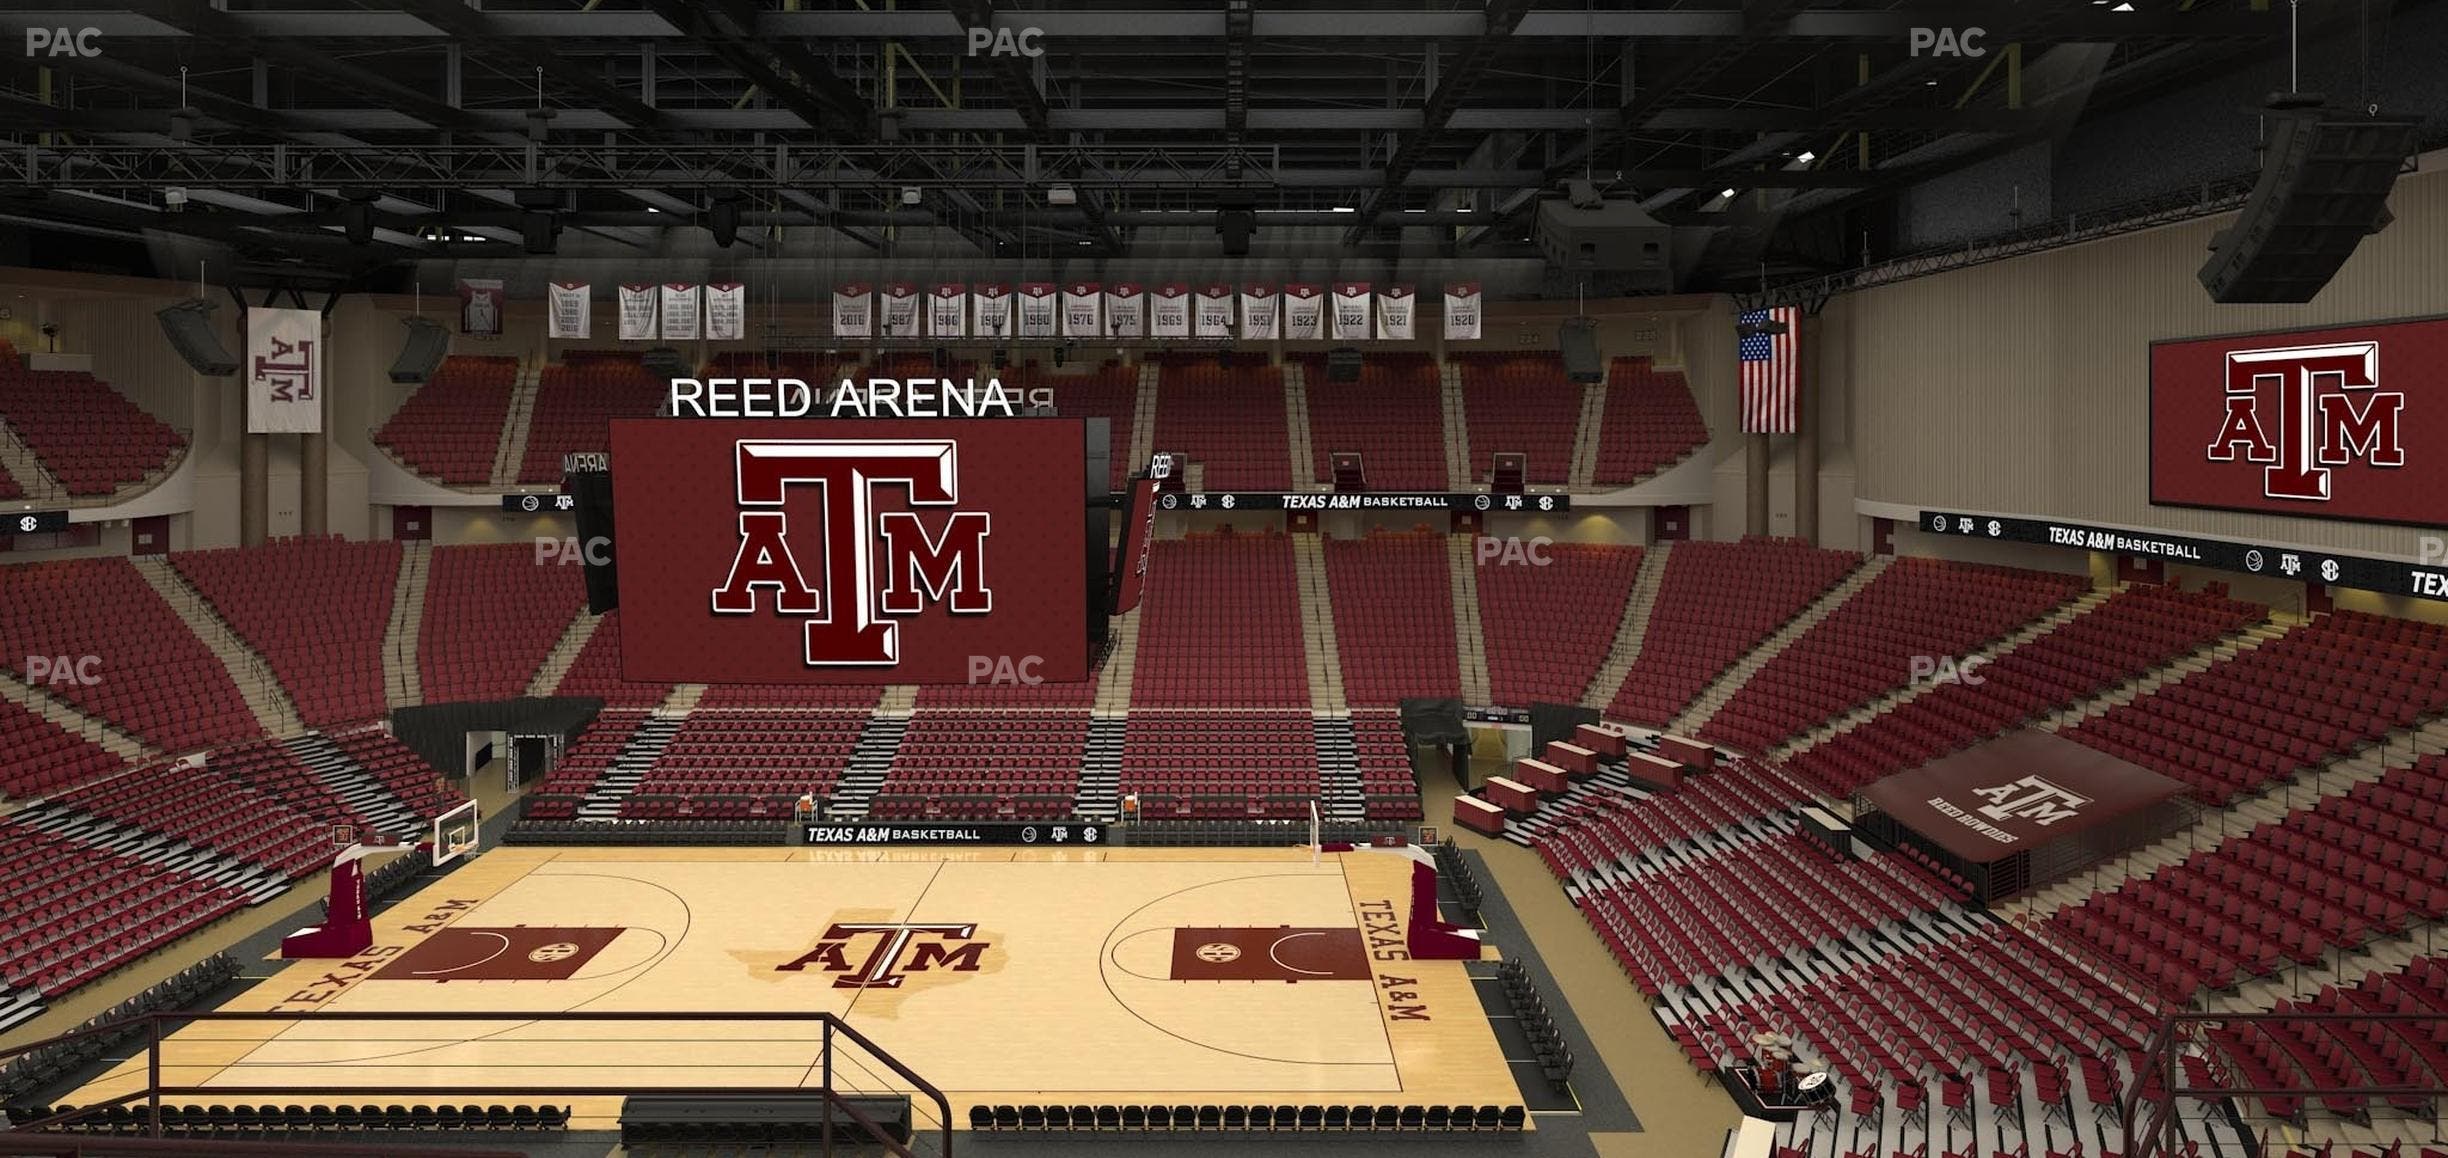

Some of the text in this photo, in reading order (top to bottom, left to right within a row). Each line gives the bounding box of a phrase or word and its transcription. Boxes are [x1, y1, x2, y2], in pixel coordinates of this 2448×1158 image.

[1068, 313, 1094, 326] 1976
[1157, 314, 1182, 326] 1969
[1292, 315, 1317, 327] 1923
[1339, 314, 1364, 326] 1922
[1385, 314, 1407, 326] 1921
[1451, 314, 1475, 326] 1920
[671, 378, 812, 418] REED
[831, 378, 1015, 418] ARENA
[1282, 495, 1450, 509] TEXAS A&M BASKETBALL
[2049, 526, 2201, 559] TEXAS A&M BASKETBALL
[1927, 796, 2019, 844] REED ROWDIES
[808, 827, 854, 842] TEXAS
[855, 827, 891, 842] A&M
[892, 829, 981, 840] BASKETBALL
[402, 899, 480, 935] A&M
[1360, 899, 1431, 1021] TEXAS A&M
